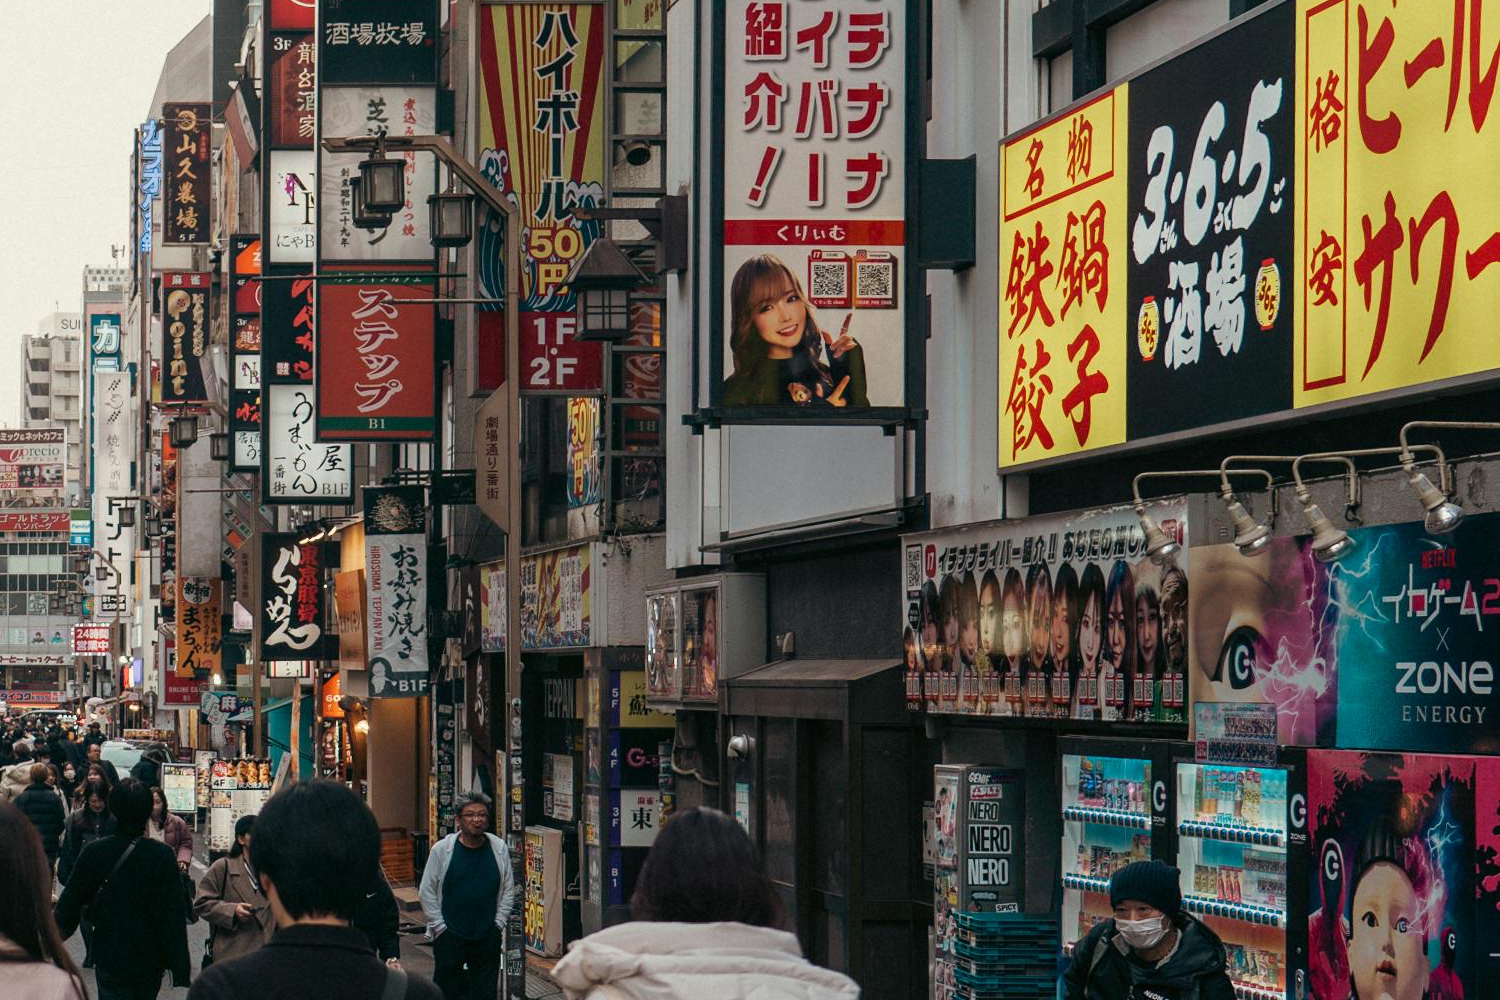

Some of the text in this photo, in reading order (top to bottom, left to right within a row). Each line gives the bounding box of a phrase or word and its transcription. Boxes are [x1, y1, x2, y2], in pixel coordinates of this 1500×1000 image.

[273, 36, 292, 51] 3F
[326, 22, 426, 45] 酒場牧場
[533, 12, 581, 224] ハイボール
[1025, 115, 1094, 200] 名物
[1307, 68, 1344, 309] 格安
[179, 233, 196, 241] 5F
[172, 274, 201, 285] 麻雀
[1004, 199, 1109, 340] 鉄鍋
[1164, 235, 1247, 371] 酒場
[1258, 275, 1277, 322] 365
[533, 319, 575, 345] 1F
[1141, 311, 1156, 353] 365
[351, 288, 404, 413] ステップ
[530, 357, 578, 385] 2F
[1006, 324, 1109, 463] 餃子
[369, 419, 385, 429] B1
[316, 445, 346, 472] 屋
[485, 416, 499, 500] 劇場通り一番街
[274, 456, 287, 496] 一番街
[322, 481, 349, 495] B1F
[1420, 548, 1457, 569] NETFLIX
[371, 546, 383, 650] HIROSHIMA TEPPANYAKI
[387, 544, 425, 659] お好み焼き
[398, 680, 428, 692] B1F
[1402, 705, 1487, 724] ENERGY
[213, 779, 225, 787] 4F
[970, 802, 998, 821] NERO
[970, 826, 1011, 852] NERO
[967, 858, 1010, 886] NERO
[995, 903, 1017, 912] SPICY
